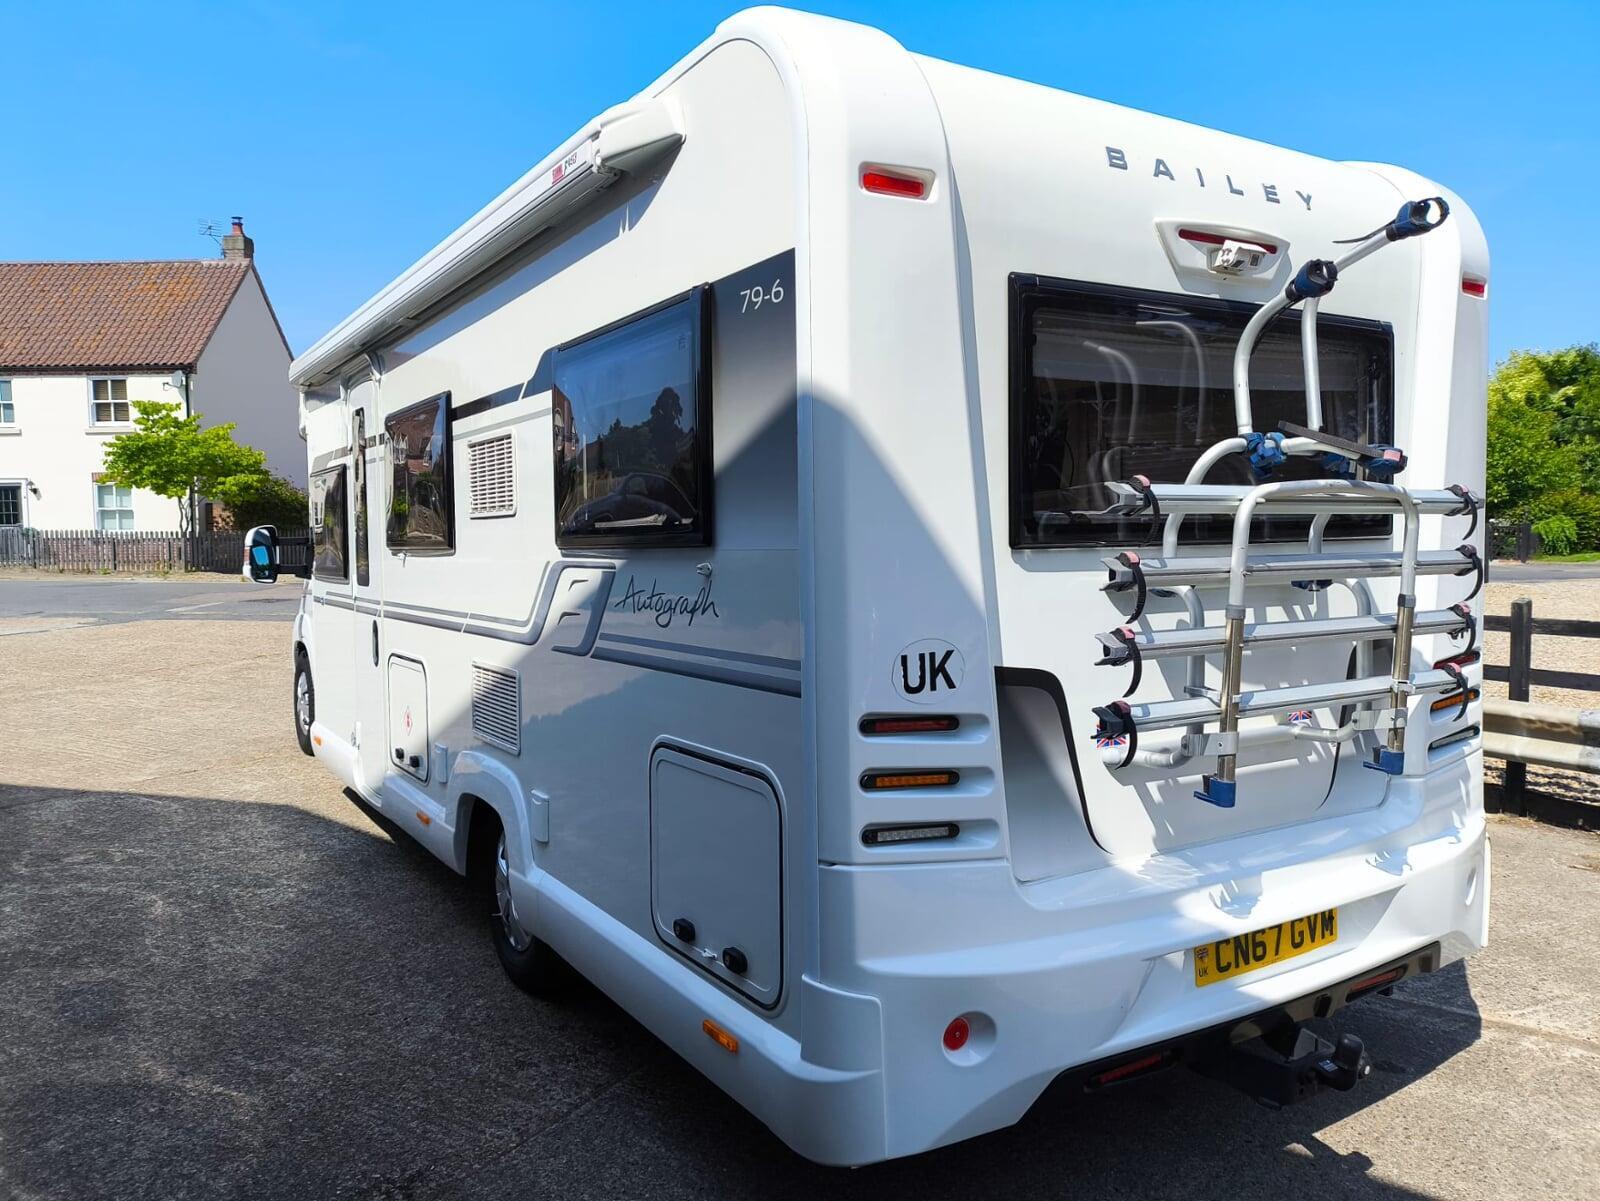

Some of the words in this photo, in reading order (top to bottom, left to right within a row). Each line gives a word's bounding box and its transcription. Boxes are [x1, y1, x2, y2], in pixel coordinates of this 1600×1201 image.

[1105, 146, 1312, 211] BAILEY
[740, 278, 784, 313] 79-6
[614, 574, 719, 628] Autograph
[900, 649, 957, 695] UK
[1215, 922, 1283, 974] CN67
[1290, 908, 1334, 950] GVM
[1198, 966, 1209, 978] UK
